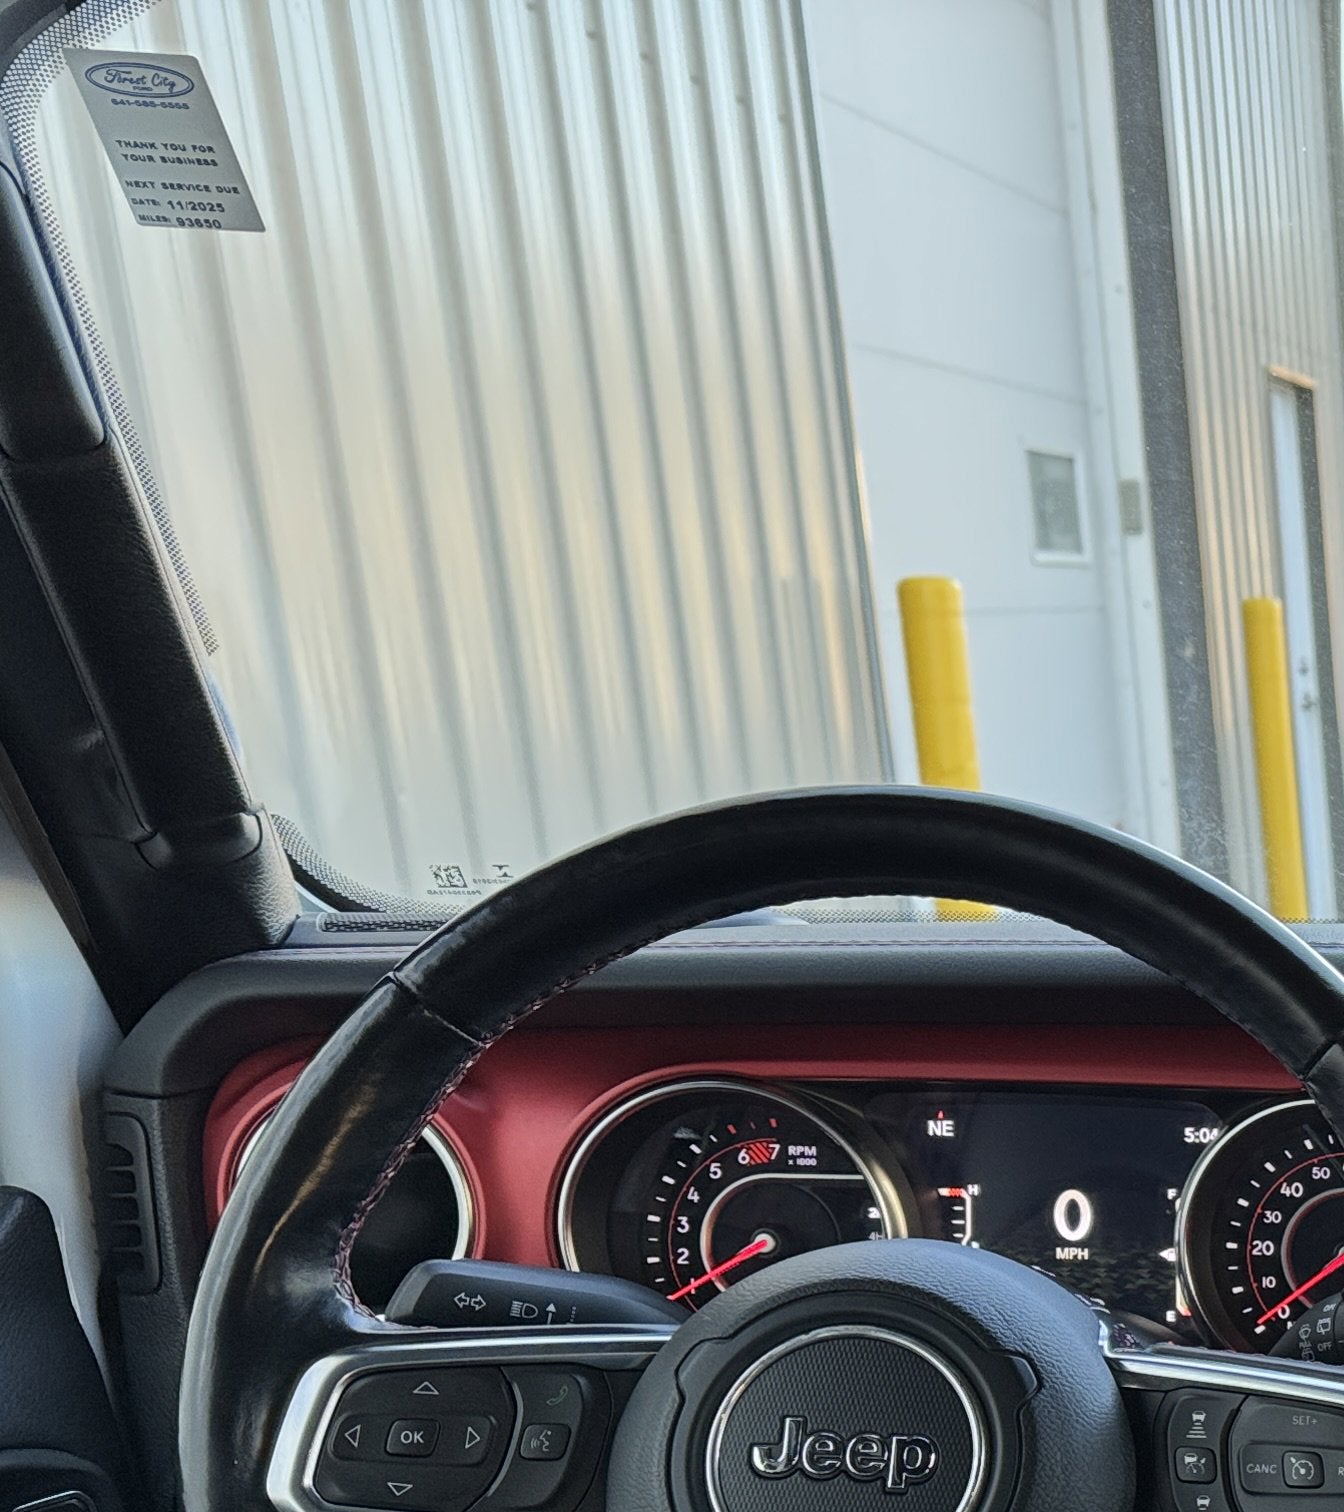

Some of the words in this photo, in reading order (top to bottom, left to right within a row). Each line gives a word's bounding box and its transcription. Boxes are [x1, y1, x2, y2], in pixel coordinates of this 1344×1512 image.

[104, 69, 147, 85] Forest
[151, 73, 176, 93] City
[115, 140, 157, 150] THANK
[163, 143, 186, 151] YOU
[192, 145, 215, 153] FOR
[122, 154, 154, 163] YOUR
[160, 156, 218, 166] BUSINESS
[125, 180, 156, 189] NEXT
[161, 182, 211, 193] SERVICE
[216, 185, 240, 194] DUE
[167, 200, 225, 213] 11/2025
[176, 217, 222, 228] 93650
[927, 1120, 955, 1137] NE
[737, 1148, 749, 1165] 6
[770, 1144, 781, 1160] 7
[788, 1146, 817, 1157] RPM
[709, 1163, 722, 1180] 5
[1312, 1167, 1330, 1179] 50
[687, 1187, 699, 1203] 4
[967, 1184, 979, 1196] H
[1167, 1189, 1177, 1199] F
[1280, 1182, 1303, 1197] 40
[1054, 1189, 1092, 1241] 0
[1264, 1211, 1282, 1223] 30
[677, 1216, 689, 1233] 3
[1055, 1247, 1089, 1260] MPH
[1252, 1240, 1274, 1256] 20
[677, 1248, 689, 1264] 2
[1262, 1277, 1276, 1288] 10
[1166, 1311, 1176, 1322] E
[1278, 1304, 1290, 1319] 0
[1317, 1342, 1332, 1351] OFF
[400, 1430, 424, 1445] OK
[752, 1416, 938, 1490] Jeep
[1246, 1464, 1277, 1474] CANC
